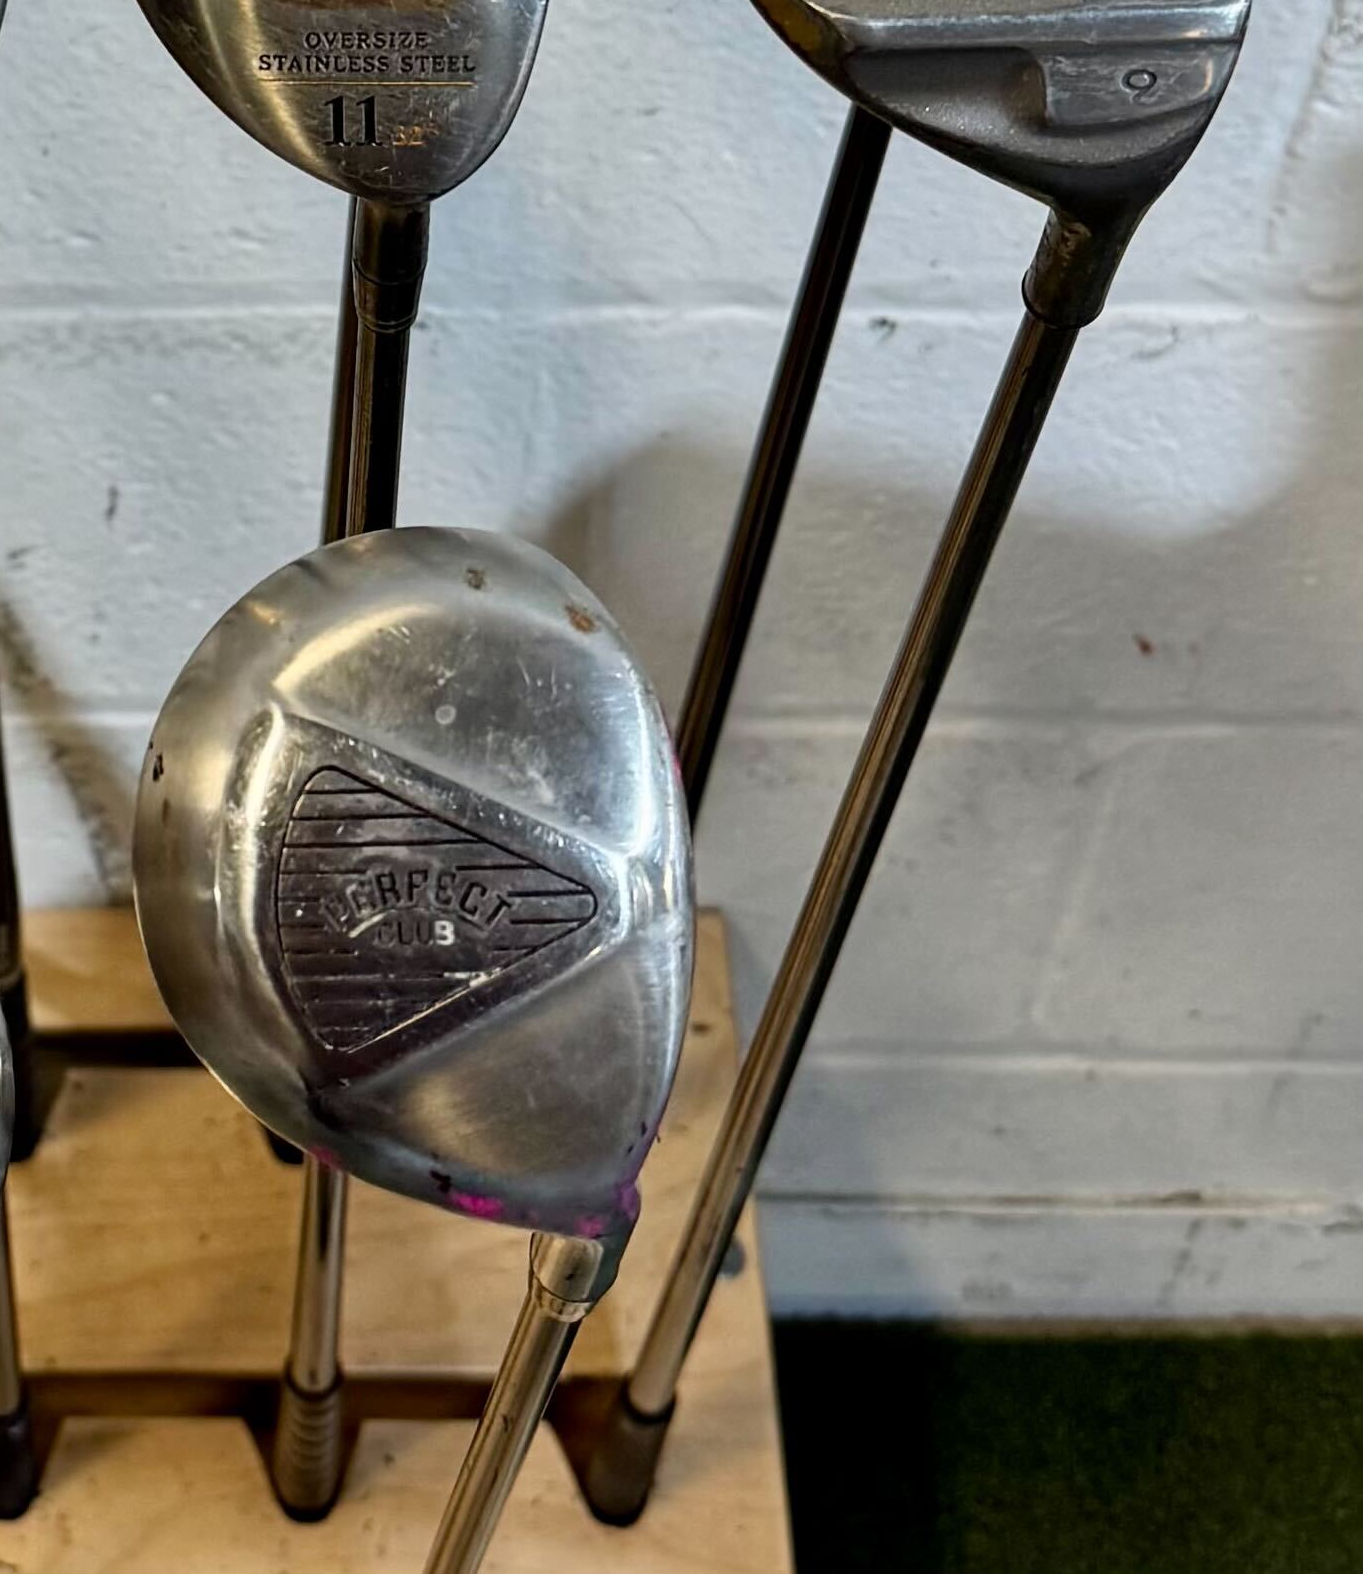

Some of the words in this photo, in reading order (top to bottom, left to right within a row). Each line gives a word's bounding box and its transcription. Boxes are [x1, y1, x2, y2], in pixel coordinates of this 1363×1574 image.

[304, 31, 430, 50] OVERSIZE
[258, 55, 390, 74] STAINLESS
[399, 54, 477, 74] STEEL
[324, 95, 383, 146] 11
[375, 918, 456, 947] CLUB
